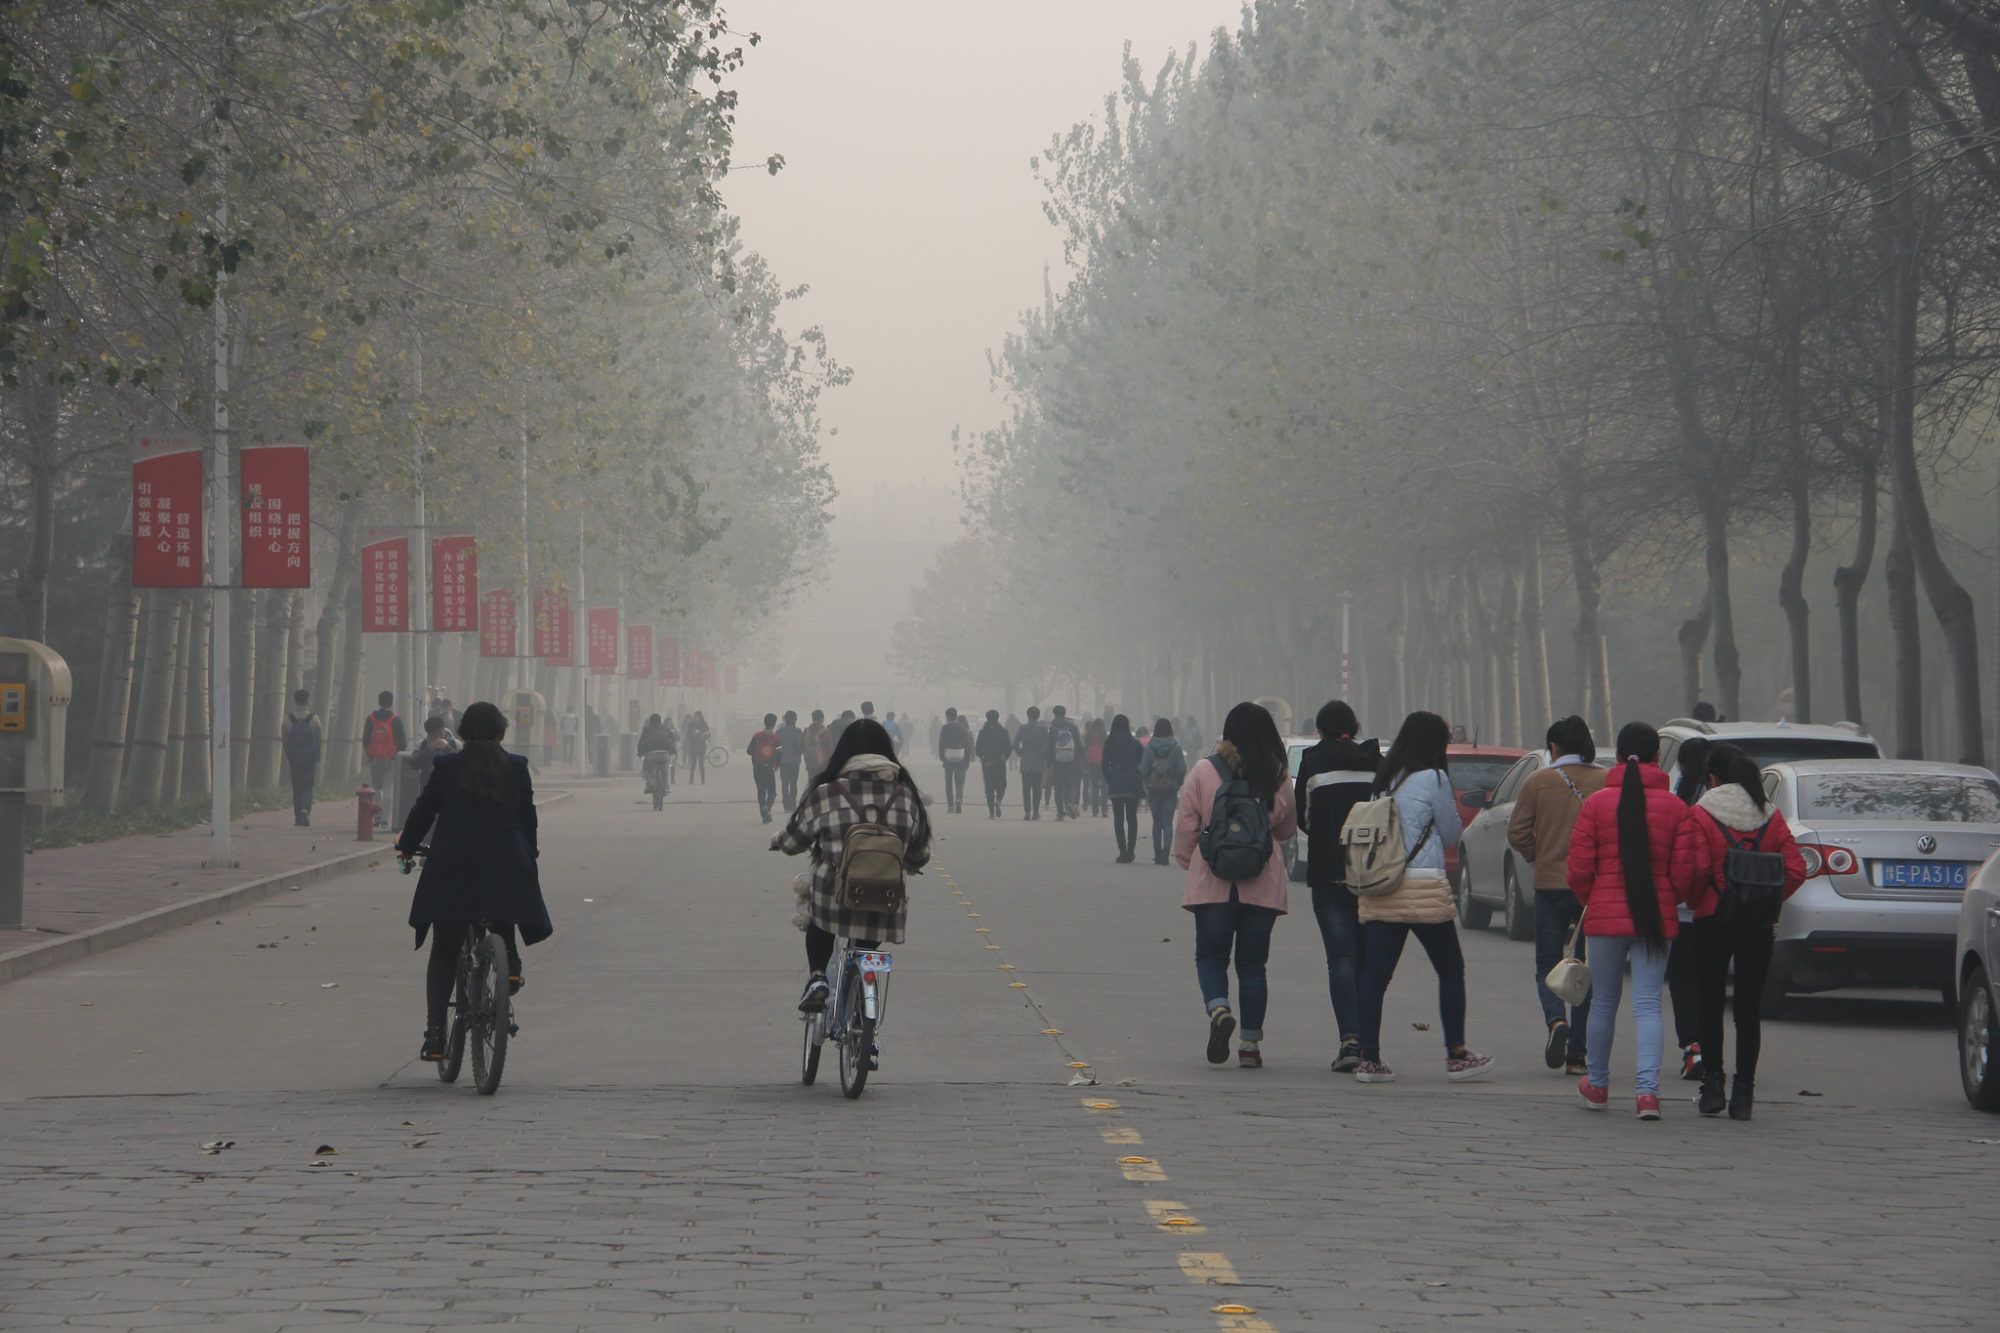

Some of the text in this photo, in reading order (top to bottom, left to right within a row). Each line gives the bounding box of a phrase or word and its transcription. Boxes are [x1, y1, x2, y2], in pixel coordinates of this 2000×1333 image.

[138, 482, 151, 537] 引领发展
[157, 497, 171, 553] 凝聚人心
[268, 498, 282, 553] 围绕中心
[176, 512, 191, 568] 营造环境
[287, 513, 301, 568] 把握方向
